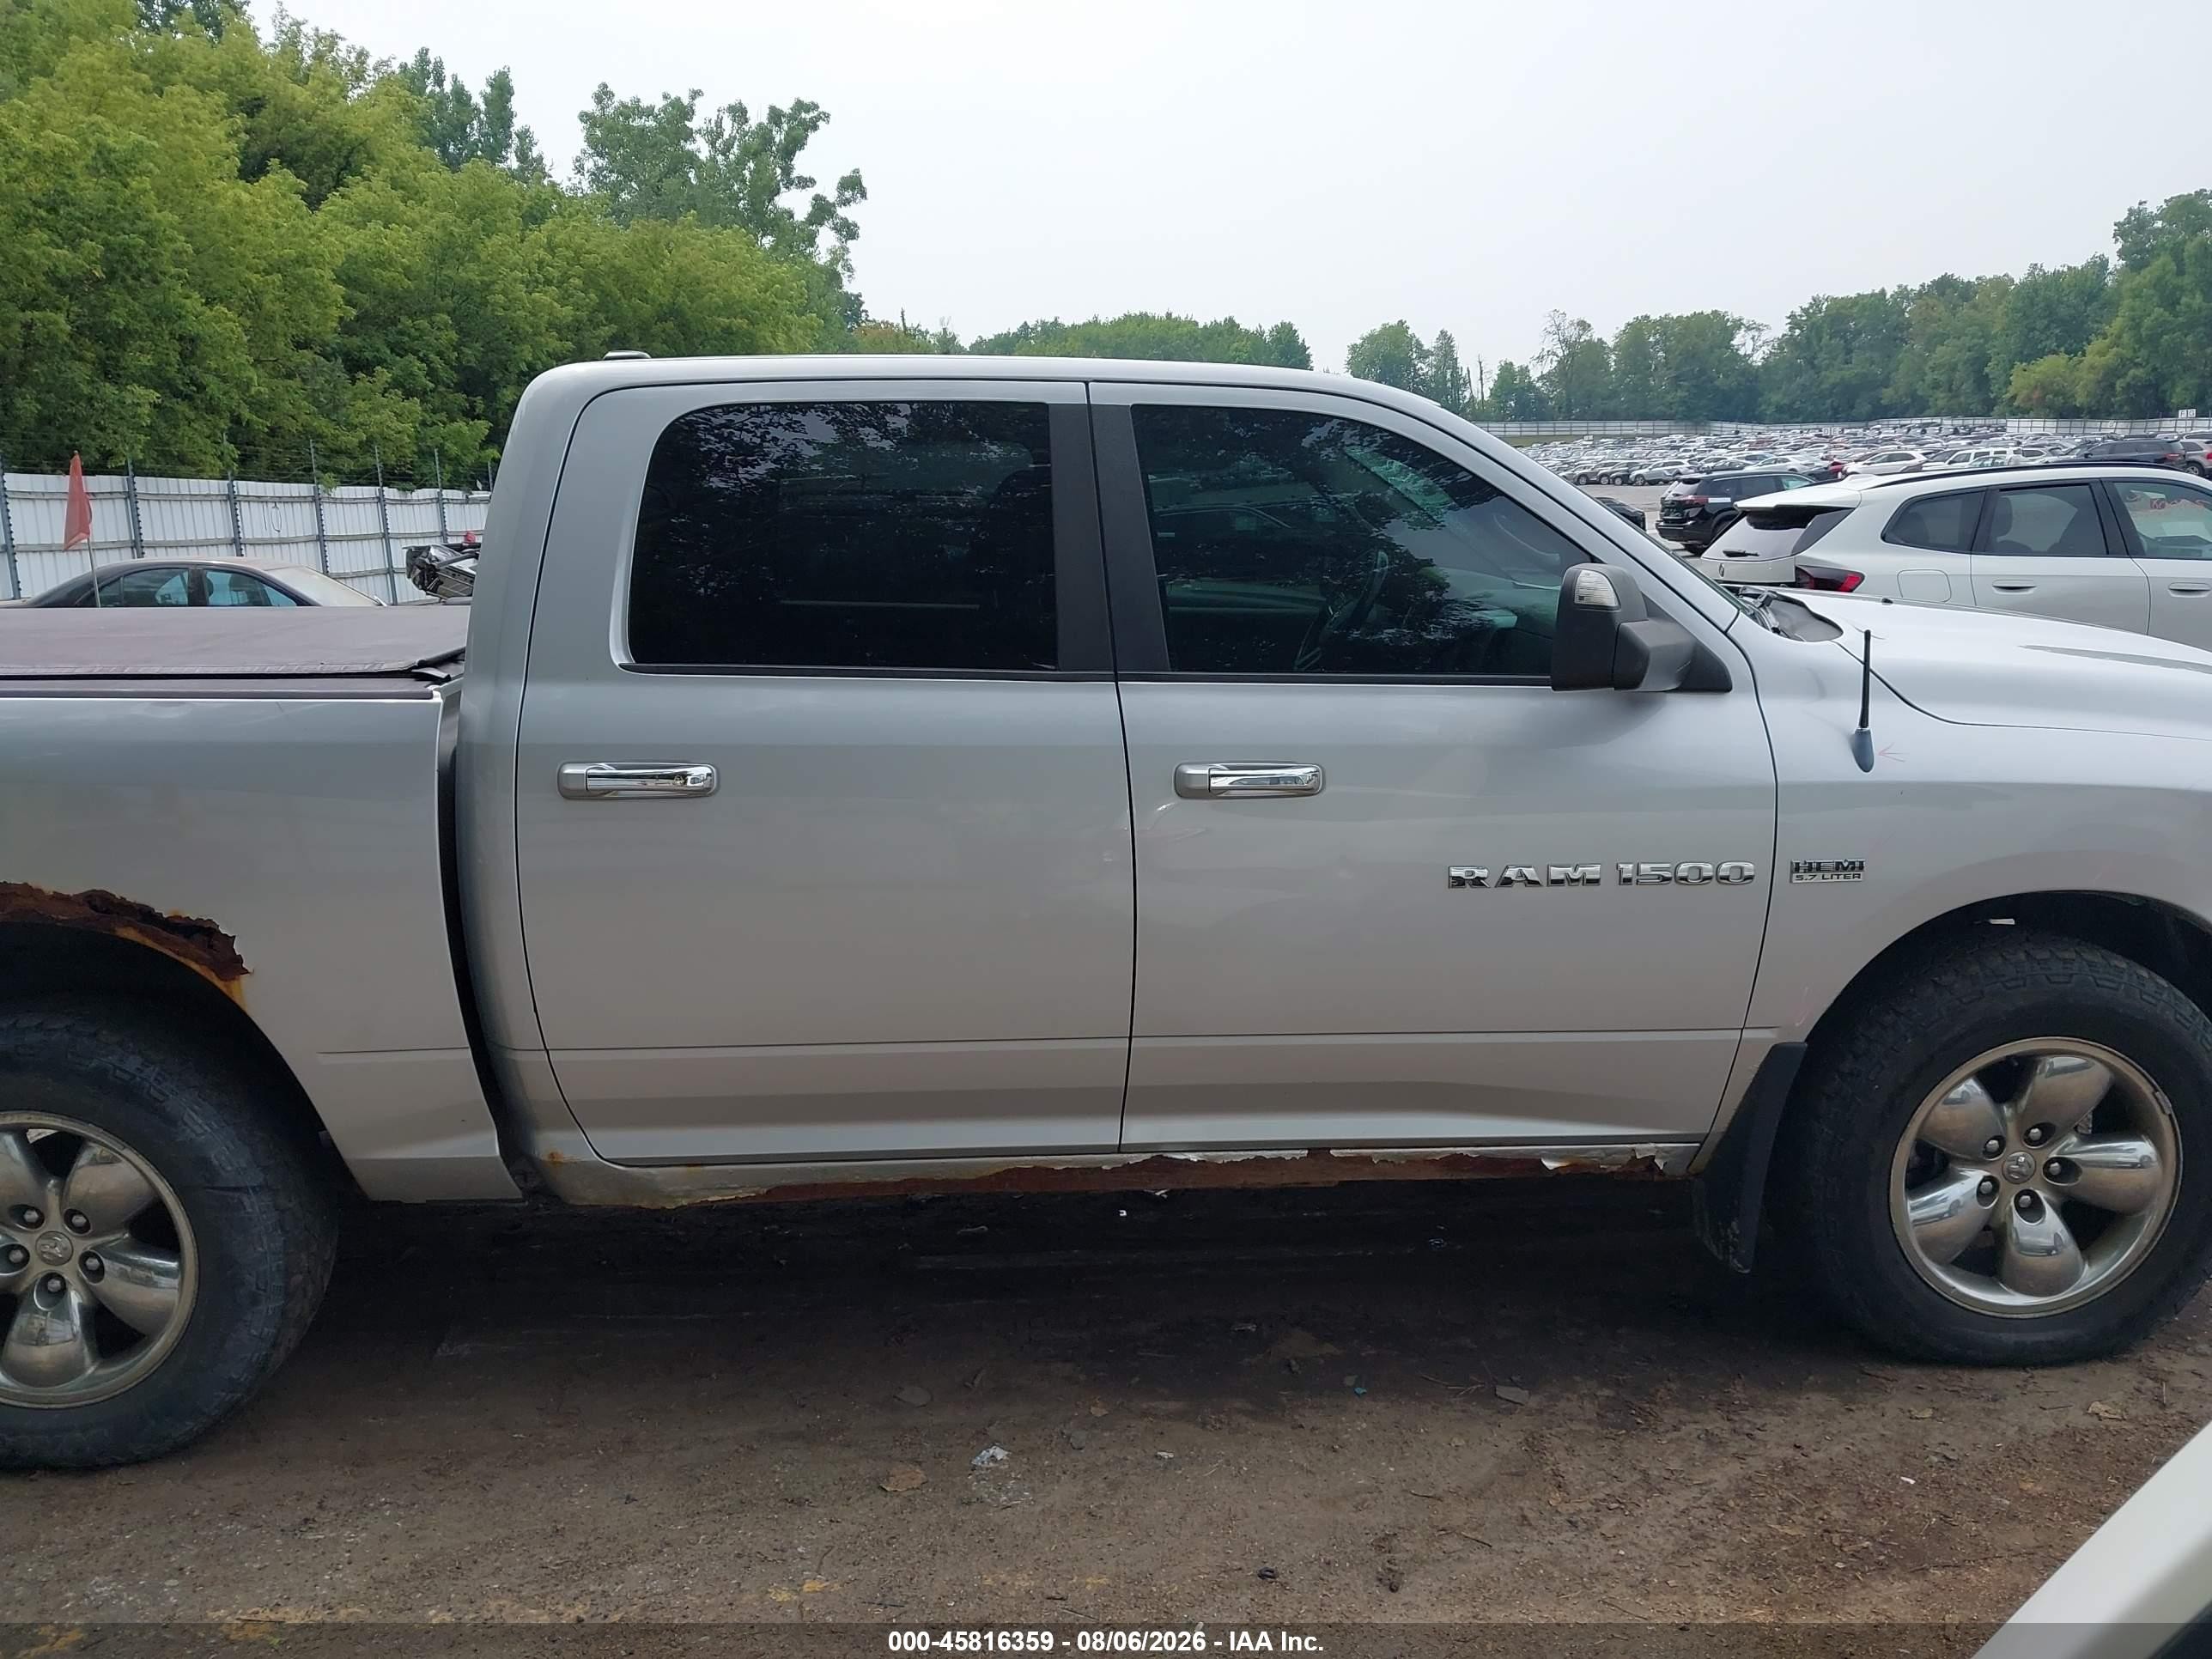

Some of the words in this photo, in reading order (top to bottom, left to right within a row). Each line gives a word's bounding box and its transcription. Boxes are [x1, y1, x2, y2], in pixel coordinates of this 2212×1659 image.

[1791, 859, 1865, 873] HEMI
[1449, 864, 1602, 889] RAM
[1616, 861, 1755, 886] 1500
[1821, 872, 1862, 881] LITER
